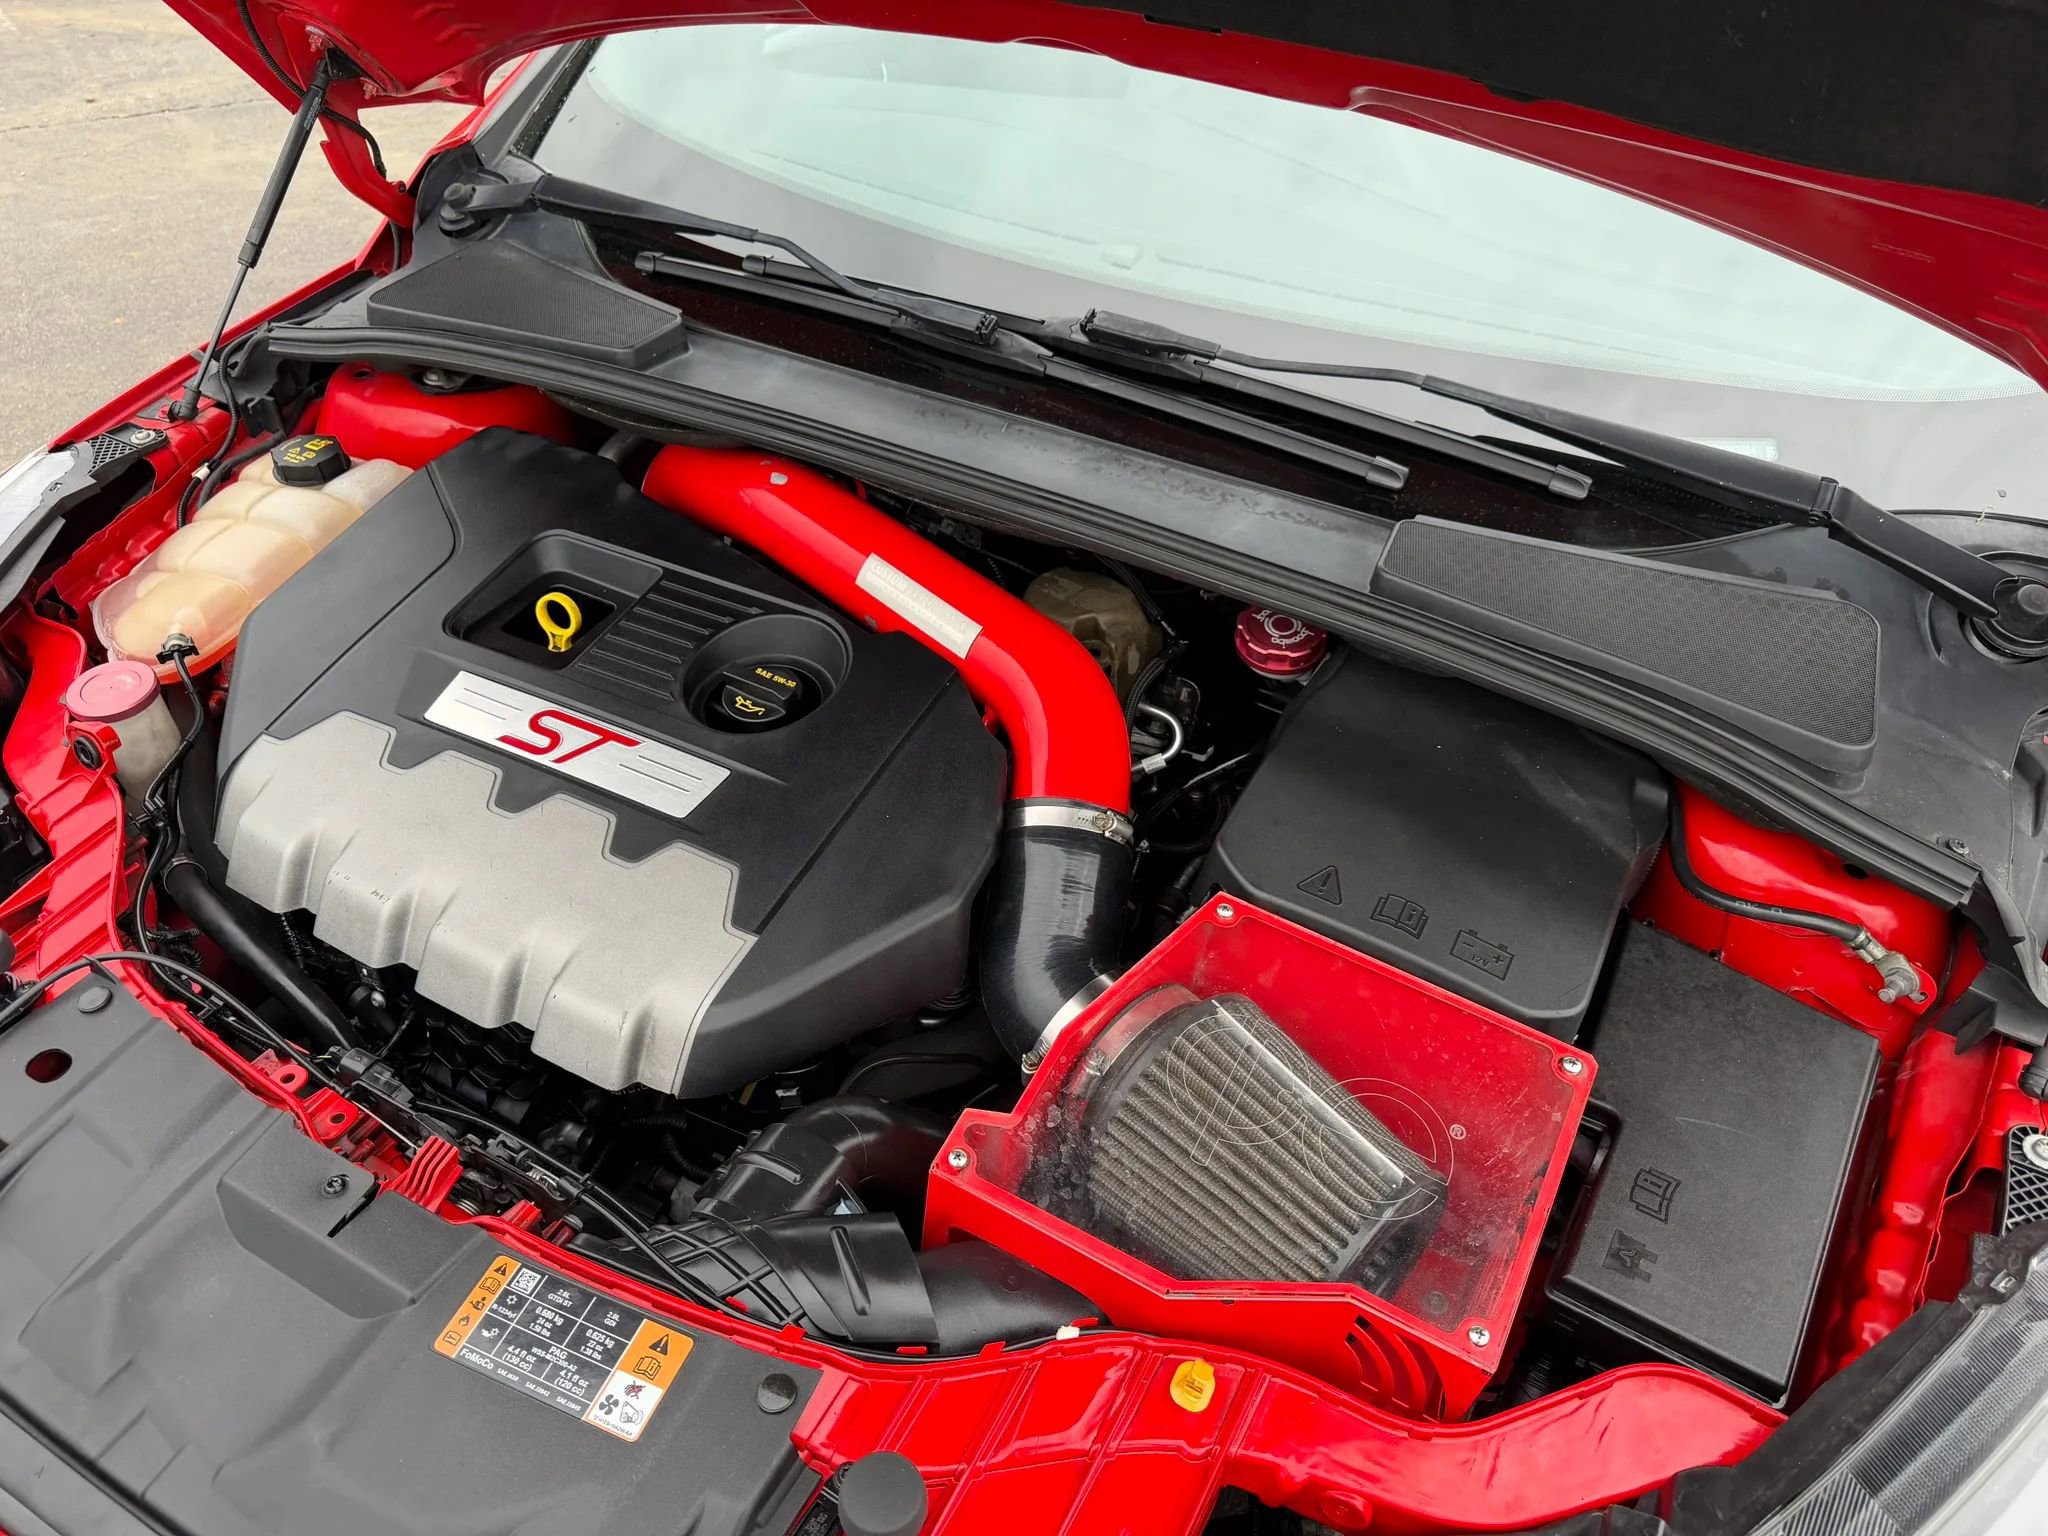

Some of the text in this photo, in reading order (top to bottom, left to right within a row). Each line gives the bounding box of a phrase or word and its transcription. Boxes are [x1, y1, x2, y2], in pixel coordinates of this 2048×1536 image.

[755, 667, 797, 688] SAE 5W-30
[496, 709, 645, 764] ST
[557, 1288, 571, 1299] 2.0L
[562, 1299, 574, 1308] ST
[491, 1303, 518, 1319] R-1234yf
[535, 1306, 564, 1326] 0.680 kg
[606, 1311, 620, 1322] 2.0L
[544, 1321, 553, 1329] oz
[603, 1317, 617, 1327] GDI
[540, 1328, 552, 1337] lbs
[585, 1329, 615, 1349] 0.625 kg
[548, 1345, 568, 1360] PAG
[586, 1340, 604, 1352] 22 oz
[459, 1347, 494, 1370] FoMoCo
[507, 1345, 537, 1363] 4.4 fl oz
[591, 1350, 602, 1360] lbs
[502, 1352, 533, 1372] (130 cc)
[496, 1368, 508, 1376] SAE
[559, 1369, 589, 1388] 4.1 fl oz
[525, 1381, 536, 1390] SAE
[554, 1376, 585, 1396] (120 cc)
[556, 1396, 567, 1405] SAE
